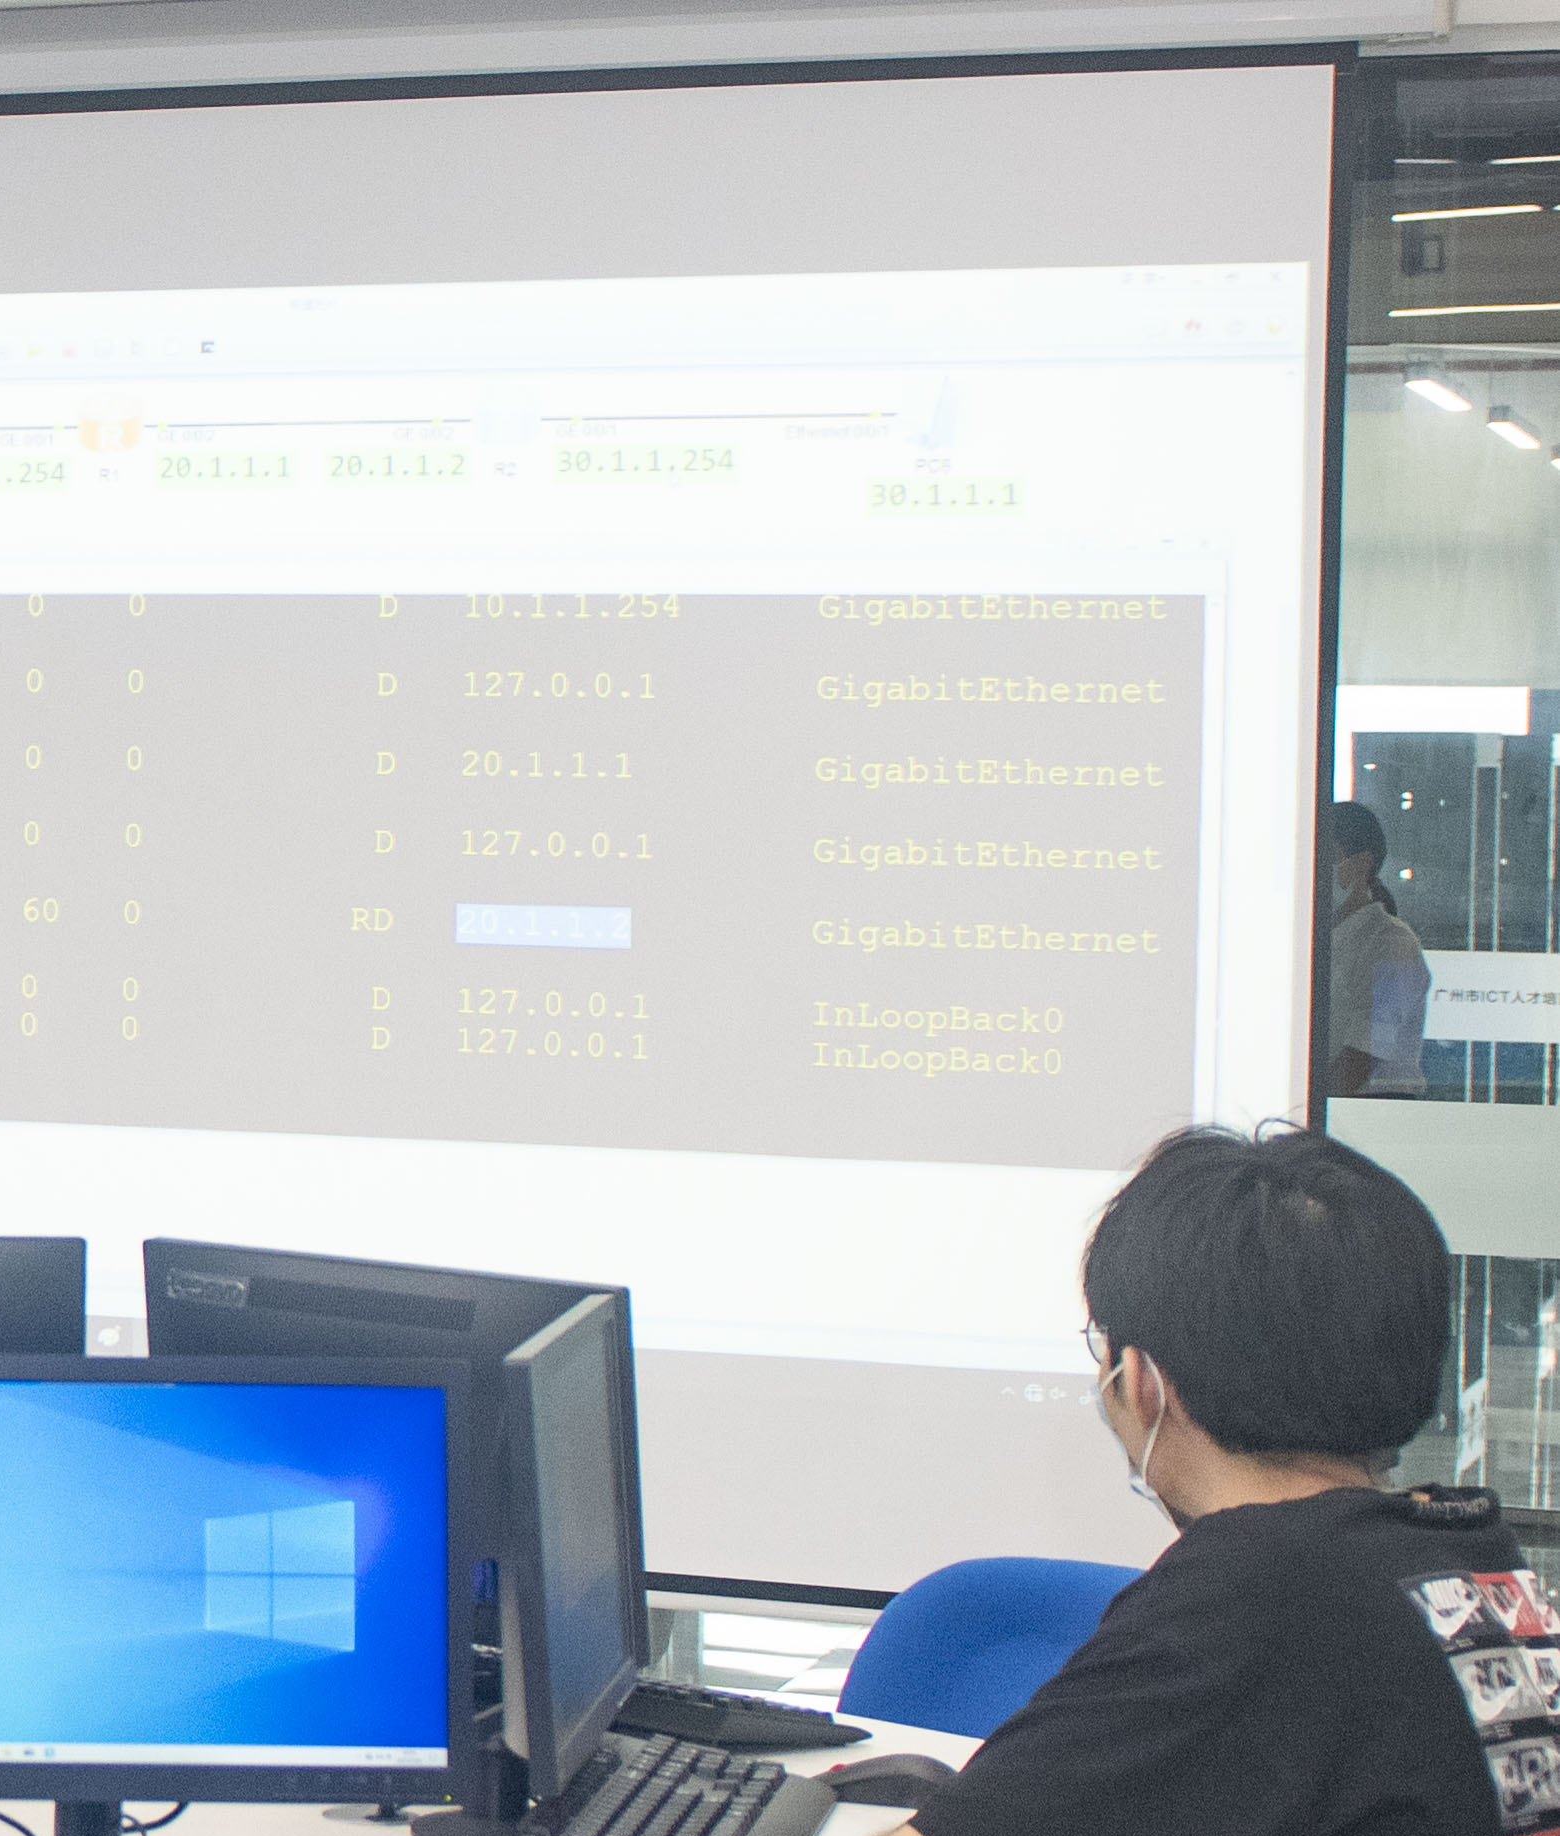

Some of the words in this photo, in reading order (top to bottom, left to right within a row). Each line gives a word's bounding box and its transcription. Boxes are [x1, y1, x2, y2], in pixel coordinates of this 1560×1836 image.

[159, 457, 290, 480] 20.1.1.1
[329, 455, 466, 478] 20.1.1.2
[557, 447, 735, 474] 30.1.1.254
[871, 482, 1019, 508] 30.1.1.1
[27, 593, 44, 618] 0
[129, 593, 147, 618] 0
[379, 594, 398, 619] D
[466, 593, 679, 620] 10.1.1.254
[818, 594, 1167, 627] GigabitEthernet
[25, 667, 44, 694] 0
[127, 668, 145, 695] 0
[377, 671, 398, 697] D
[464, 669, 655, 700] 127.0.0.1
[816, 673, 1165, 709] GigabitEthernet
[24, 744, 42, 770] 0
[126, 745, 143, 772] 0
[375, 749, 397, 776] D
[462, 749, 632, 779] 20.1.1.1
[814, 755, 1164, 790] GigabitEthernet
[22, 820, 41, 847] 0
[124, 821, 142, 849] 0
[374, 829, 396, 855] D
[462, 829, 652, 861] 127.0.0.1
[814, 835, 1162, 872] GigabitEthernet
[22, 896, 60, 923] 60
[123, 899, 142, 926] 0
[351, 906, 394, 933] RD
[458, 908, 630, 939] 20.1.1.2
[811, 917, 1159, 955] GigabitEthernet
[21, 973, 38, 1000] 0
[121, 976, 140, 1003] 0
[371, 985, 393, 1011] D
[458, 987, 648, 1020] 127.0.0.1
[813, 1000, 1064, 1036] InLoopBack0
[1434, 988, 1560, 1006] 广州市ICT人才培
[20, 1010, 38, 1038] 0
[121, 1015, 139, 1041] 0
[370, 1025, 391, 1051] D
[458, 1026, 648, 1061] 127.0.0.1
[813, 1041, 1063, 1080] InLoopBack0
